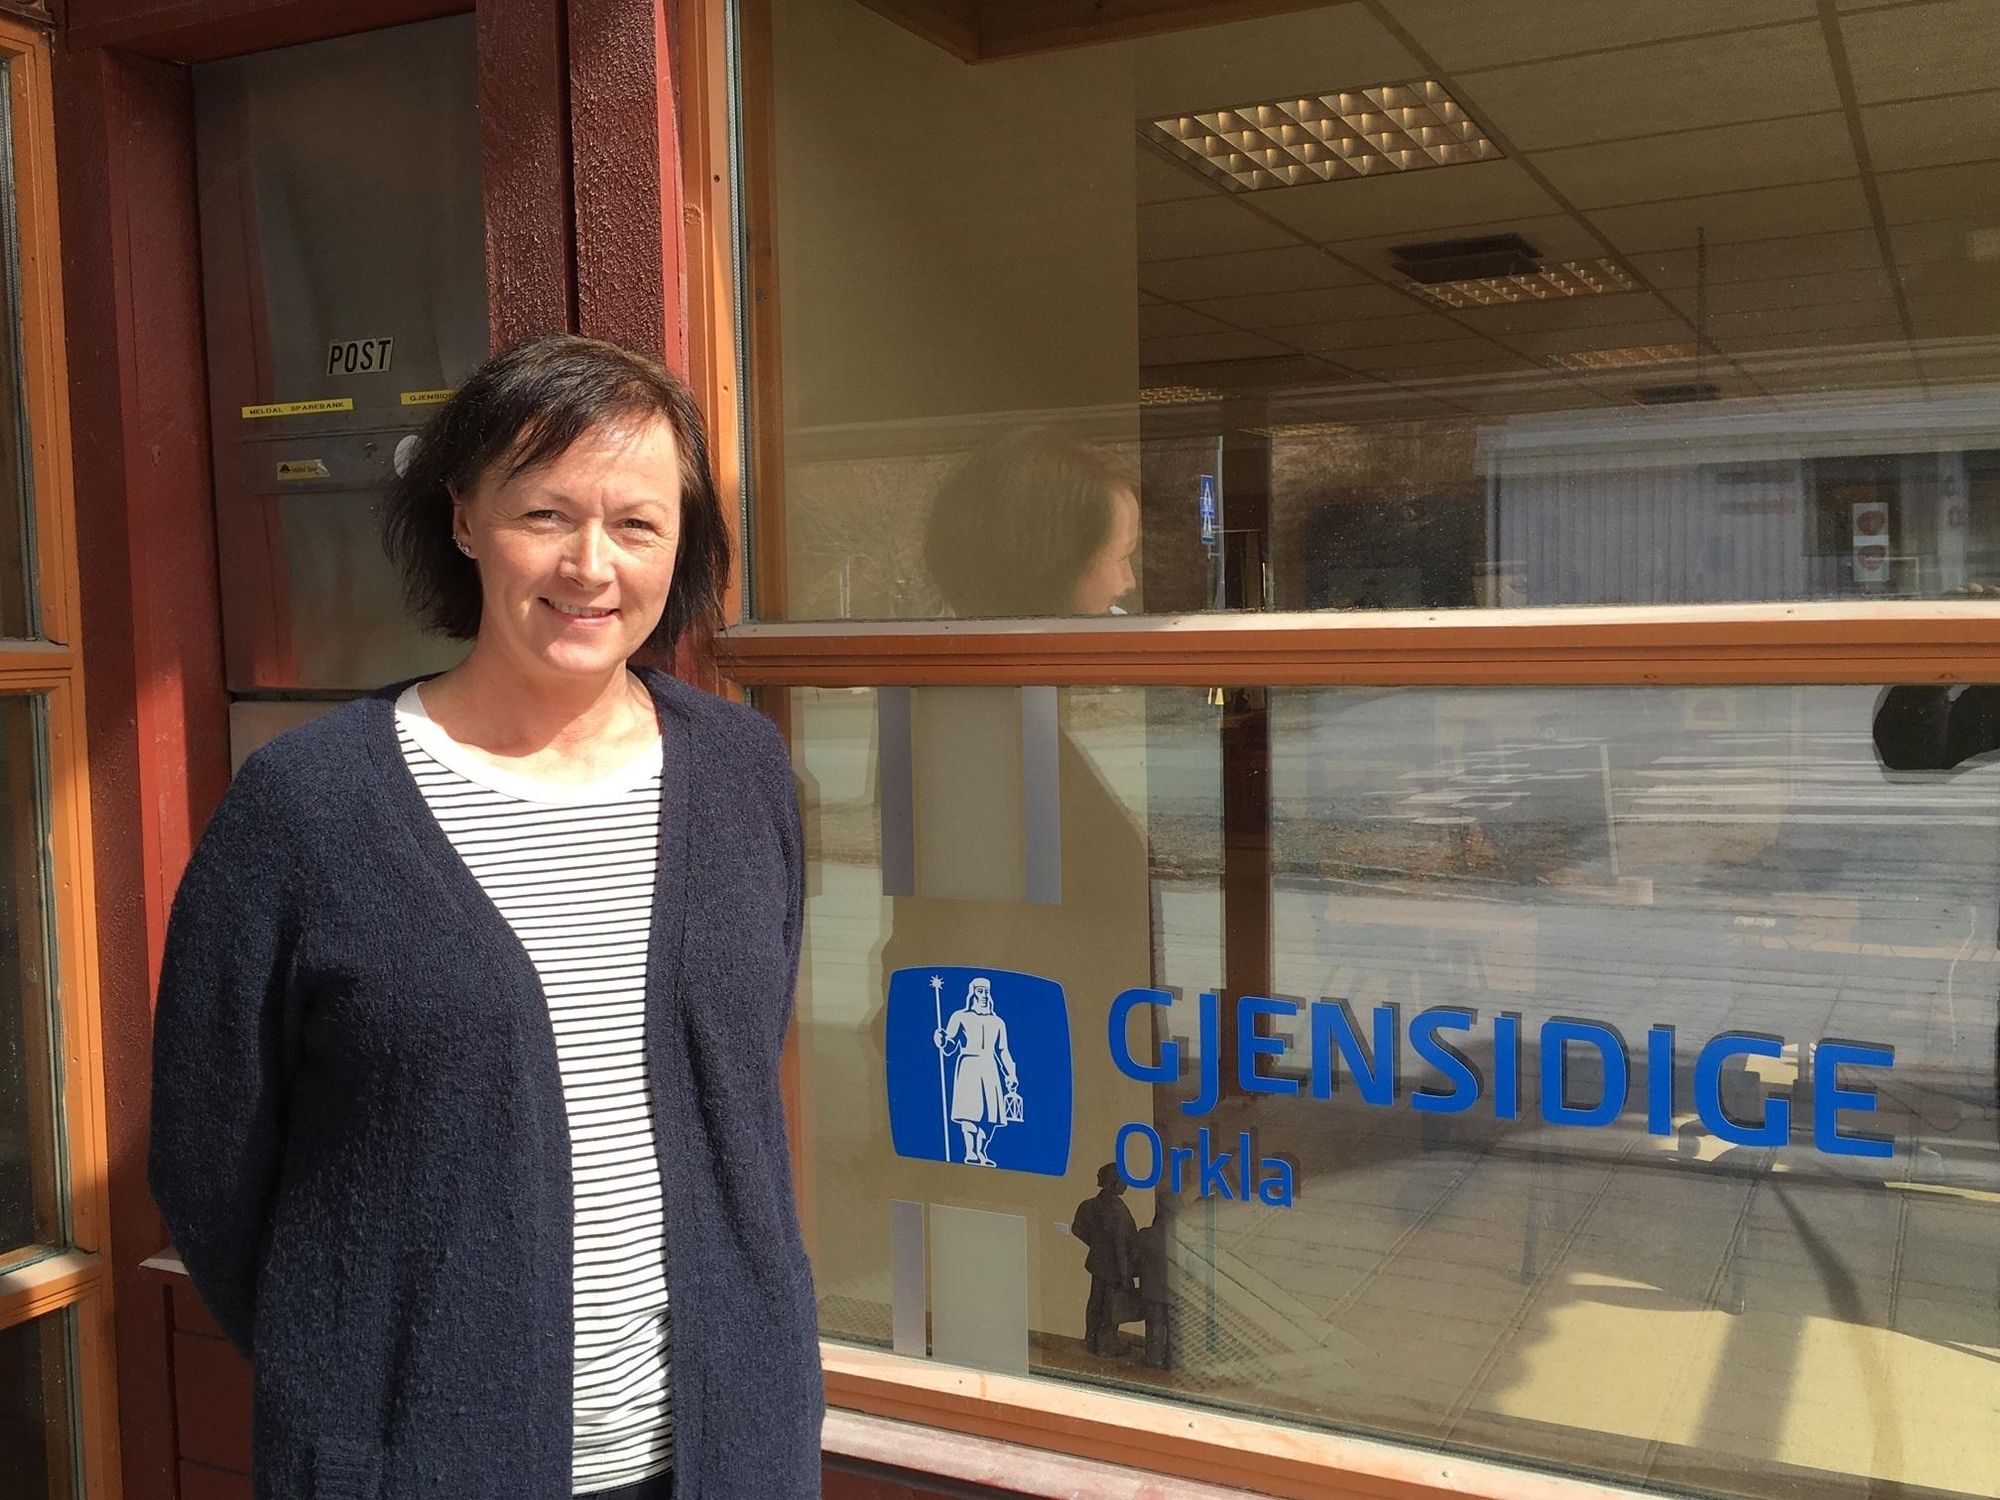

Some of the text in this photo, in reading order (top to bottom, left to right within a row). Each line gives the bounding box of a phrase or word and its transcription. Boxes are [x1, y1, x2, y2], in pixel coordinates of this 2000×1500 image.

[328, 339, 392, 374] POST
[249, 402, 345, 415] MELDAL SPAREBANK
[1107, 986, 1896, 1159] GJENSIDIGE
[1114, 1121, 1294, 1208] Orkla
